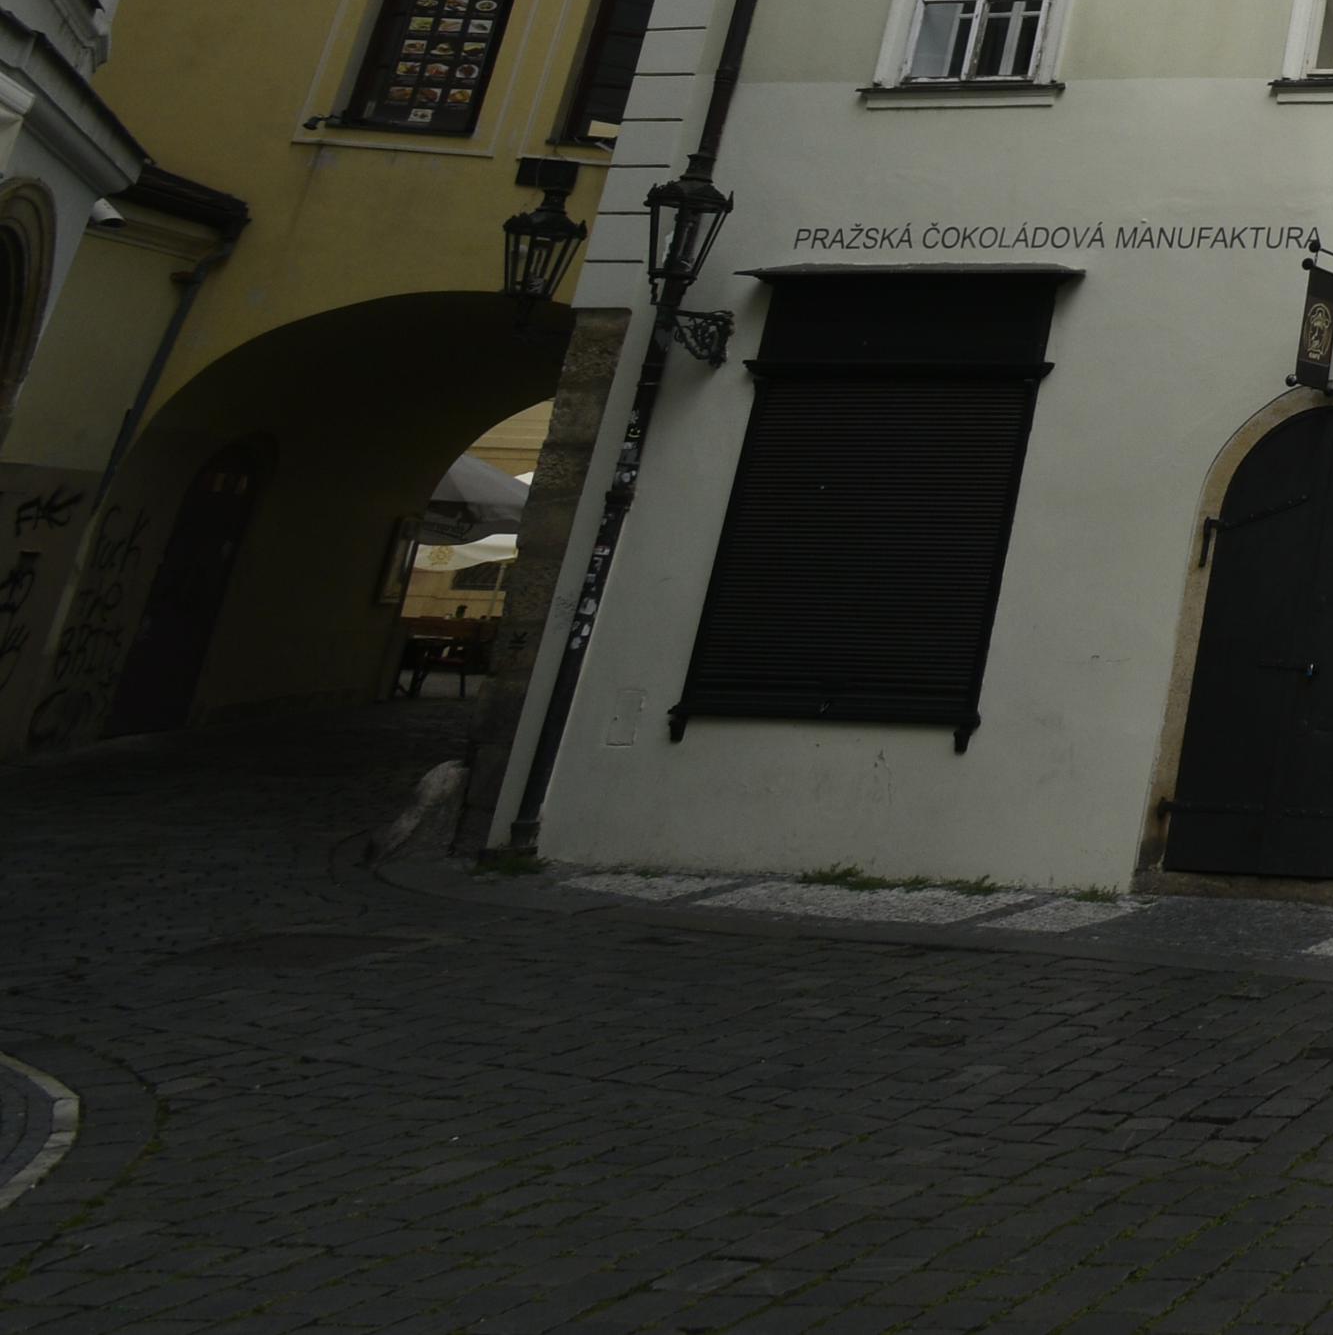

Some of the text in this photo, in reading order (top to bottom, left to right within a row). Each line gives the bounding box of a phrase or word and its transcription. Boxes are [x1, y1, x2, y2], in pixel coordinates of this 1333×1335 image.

[793, 222, 1321, 251] PRAŽSKÁ ČOKOLÁDOVÁ MANUFAKTURA
